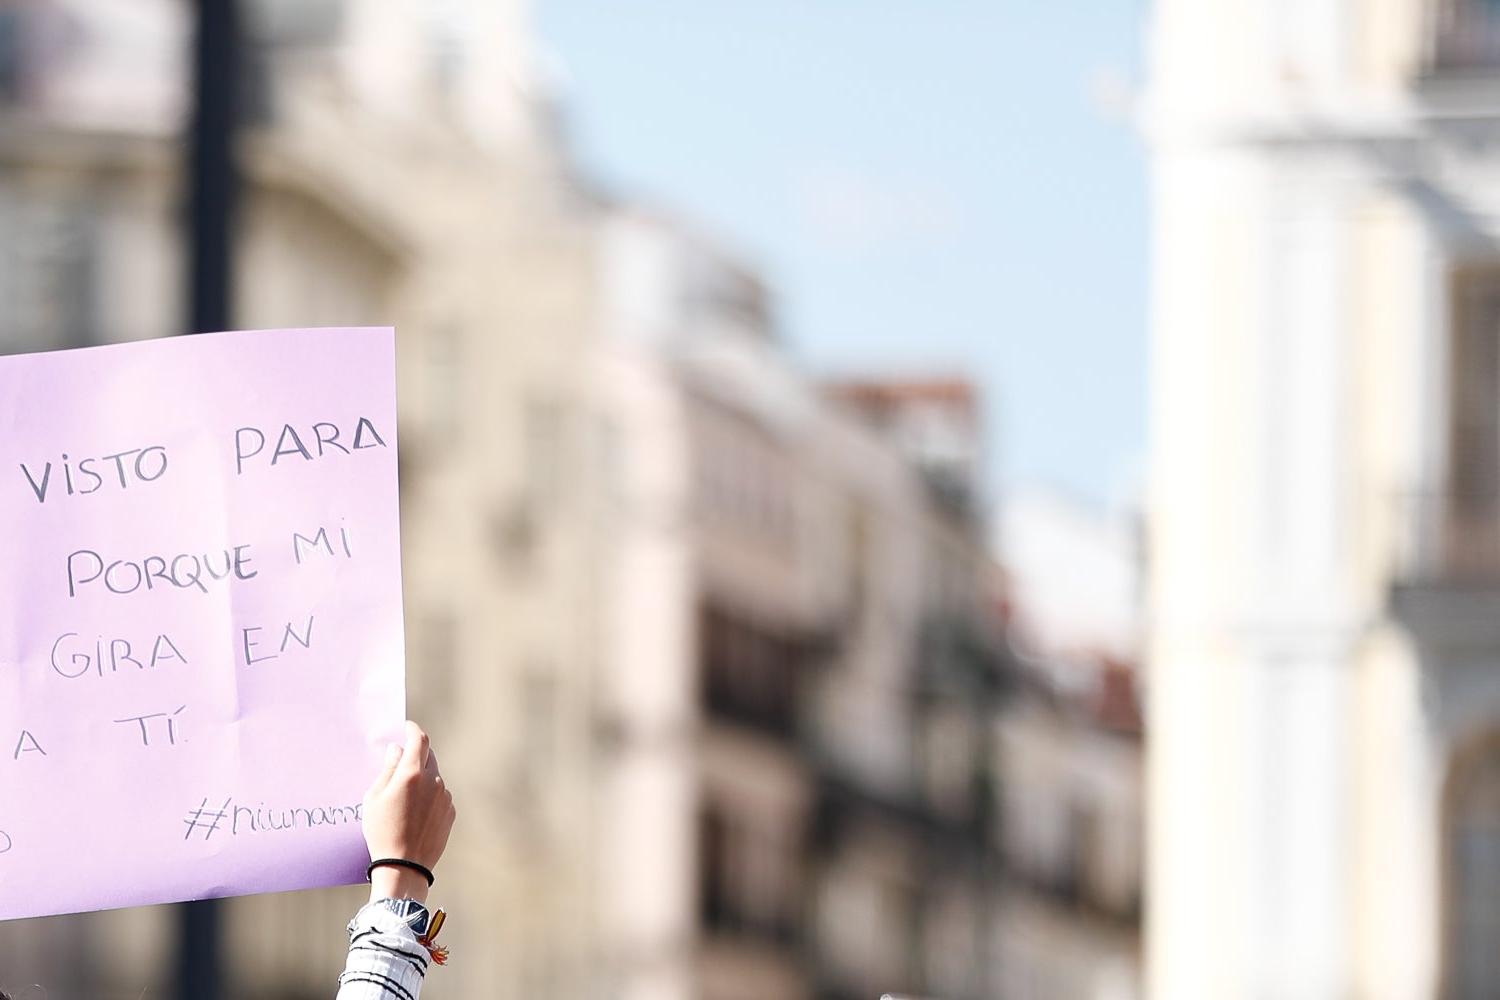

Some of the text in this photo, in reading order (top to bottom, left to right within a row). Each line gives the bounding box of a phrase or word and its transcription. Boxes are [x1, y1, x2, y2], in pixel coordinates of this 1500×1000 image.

[235, 416, 388, 475] PARA
[67, 545, 258, 598] PORQUE
[242, 615, 315, 666] EN
[13, 729, 47, 760] A
